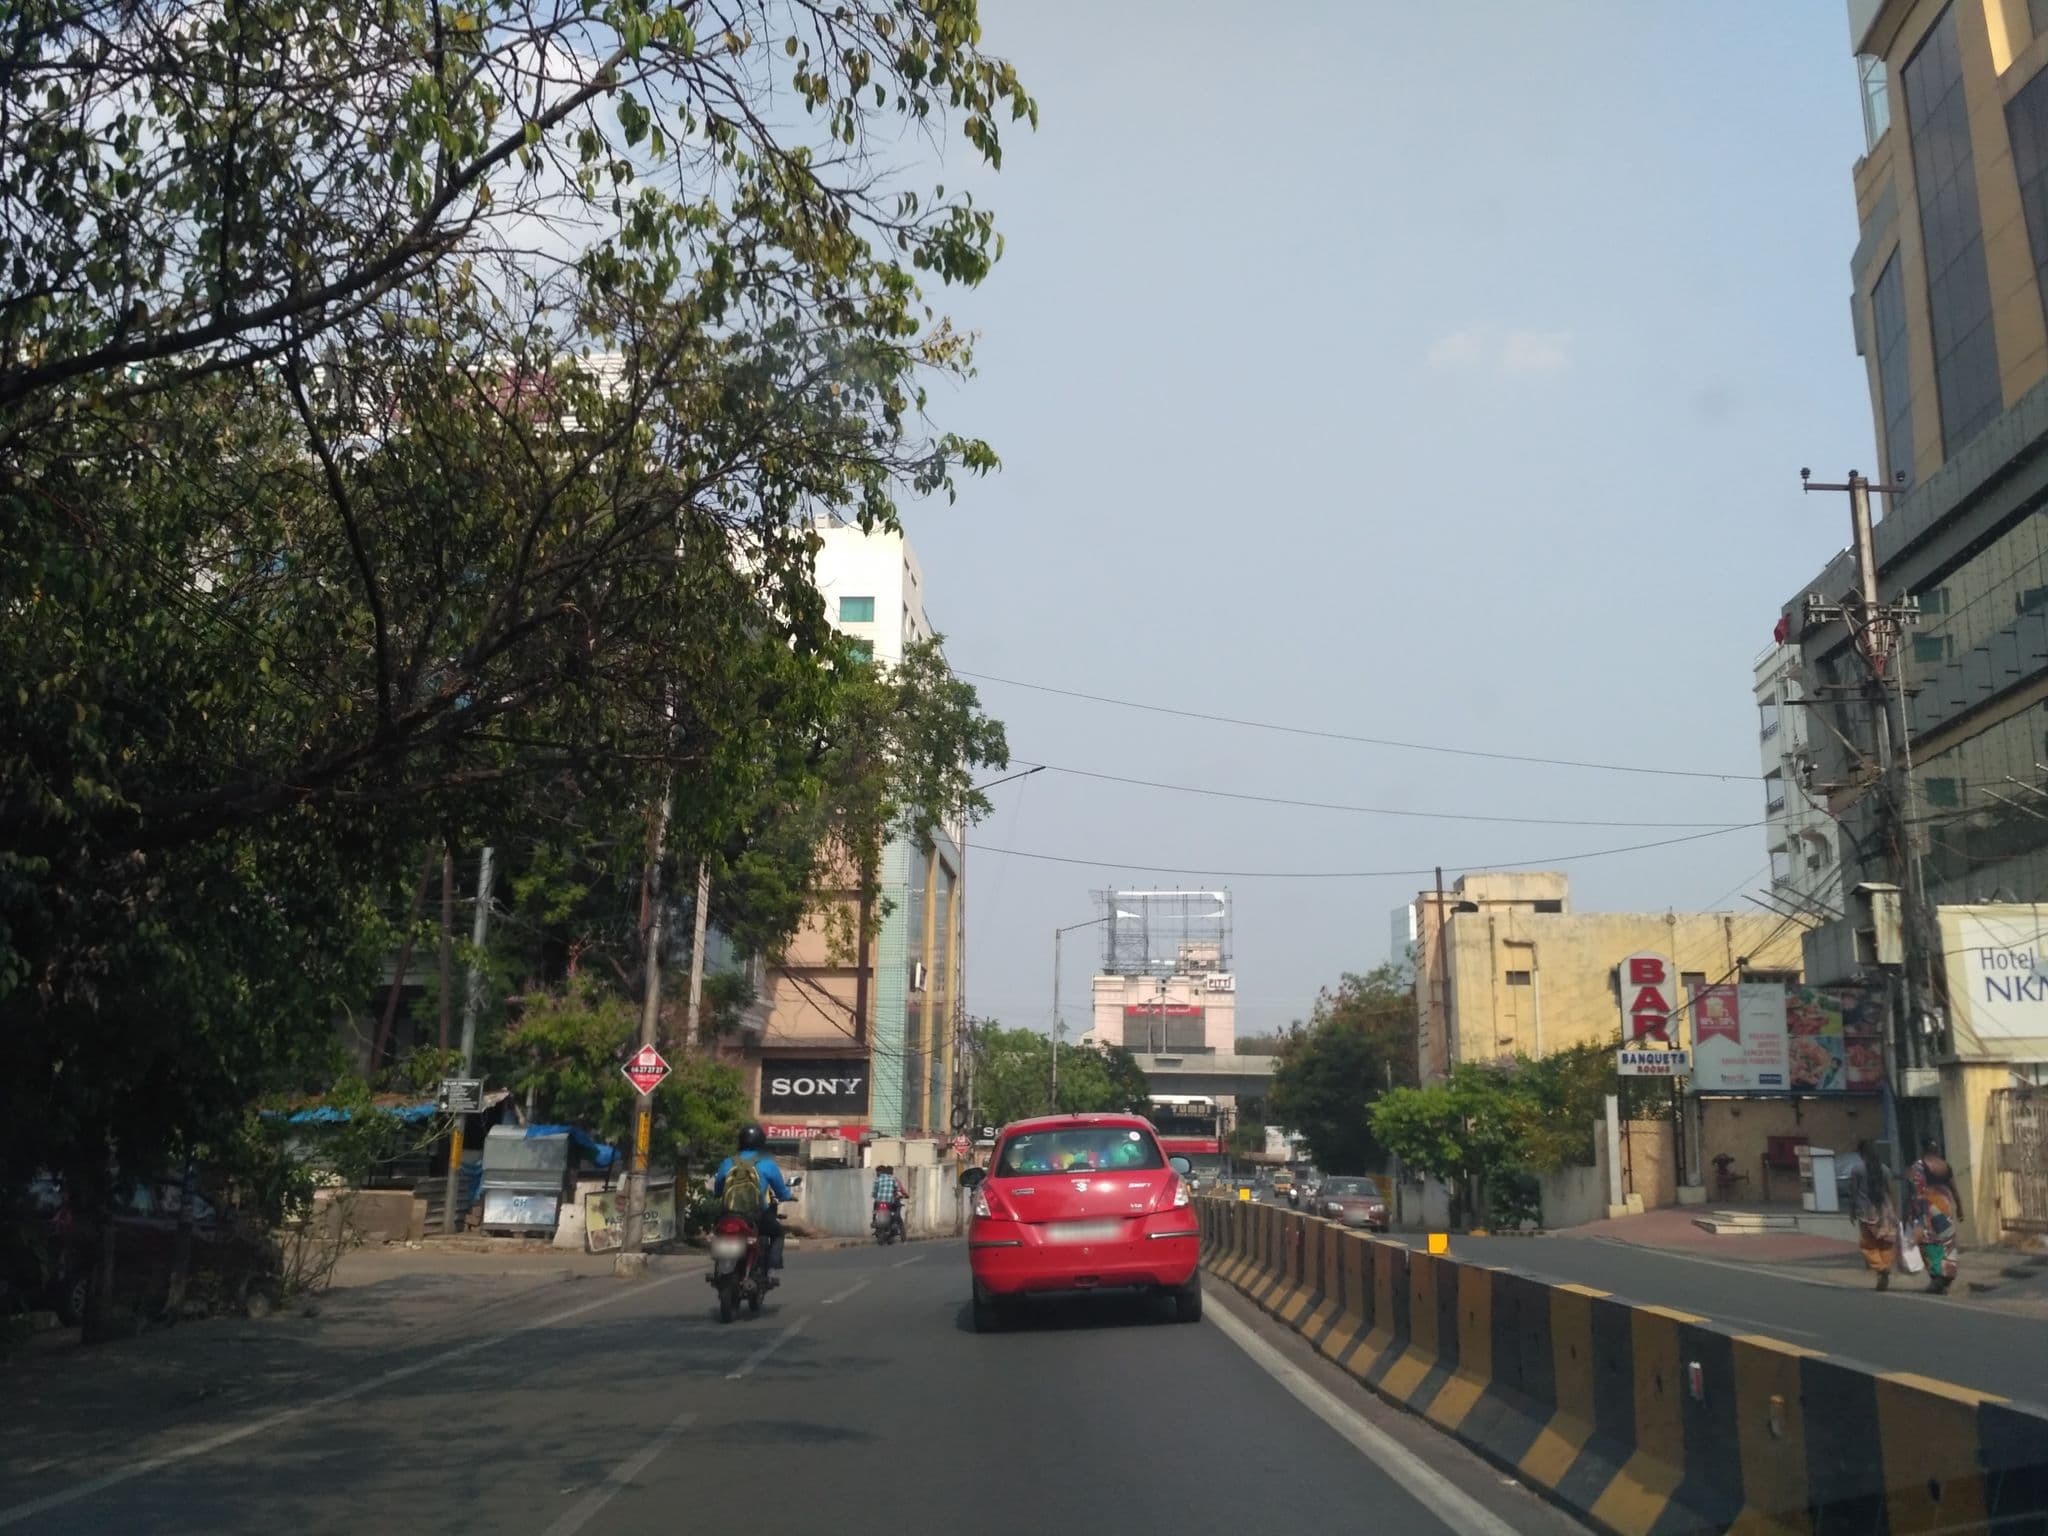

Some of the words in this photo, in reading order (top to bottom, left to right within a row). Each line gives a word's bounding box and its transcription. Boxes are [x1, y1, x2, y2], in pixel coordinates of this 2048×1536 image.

[1980, 946, 2035, 970] Hotel
[1629, 957, 1672, 1042] BAR
[1621, 1053, 1686, 1065] BANQUETS
[771, 1078, 862, 1096] SONY
[767, 1126, 824, 1138] Emirate
